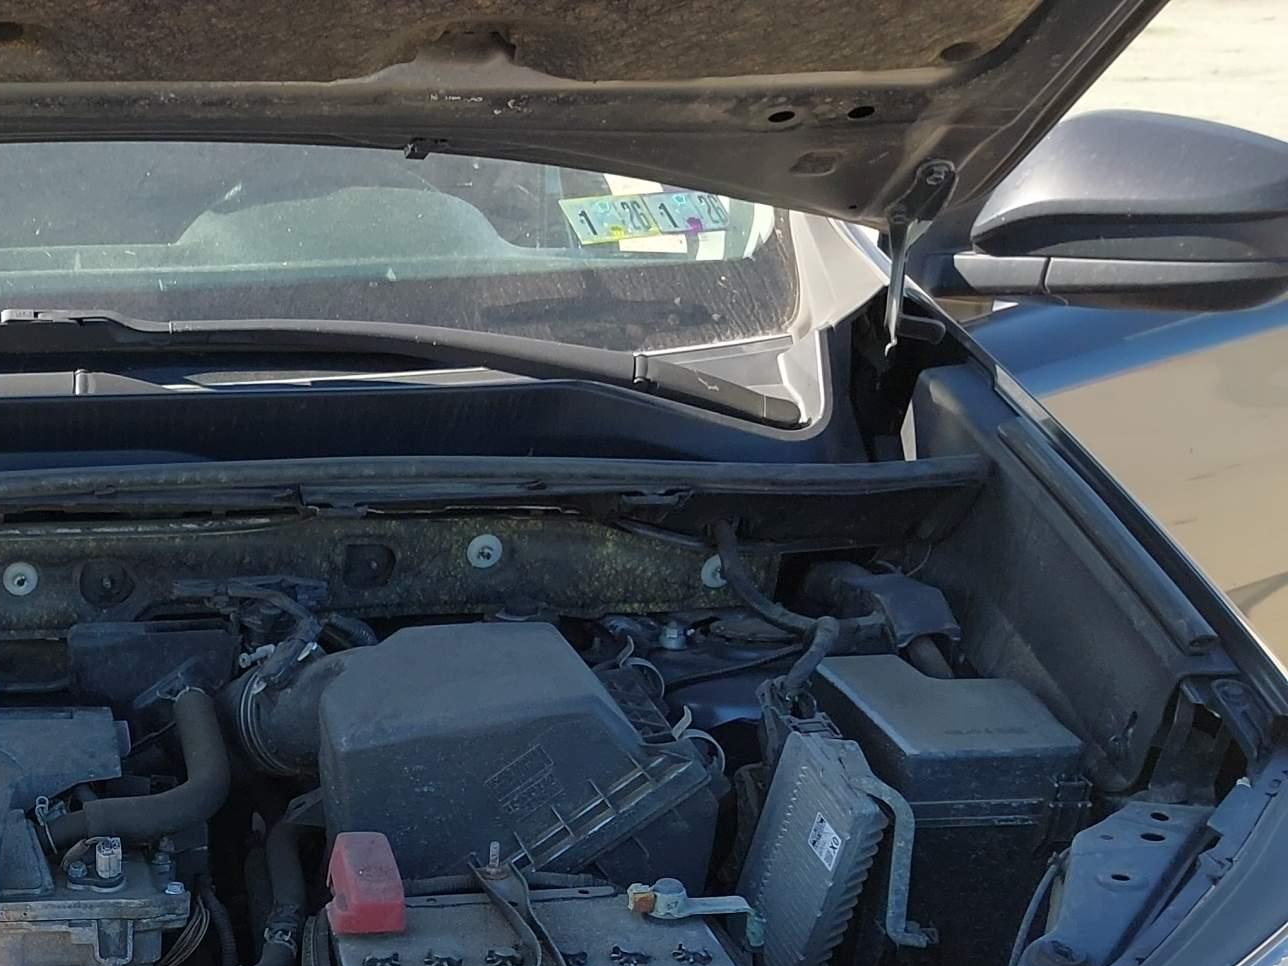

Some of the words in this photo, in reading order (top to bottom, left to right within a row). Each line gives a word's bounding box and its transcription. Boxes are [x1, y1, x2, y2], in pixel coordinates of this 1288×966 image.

[578, 209, 598, 236] 1
[620, 199, 651, 231] 26
[658, 202, 679, 228] 1
